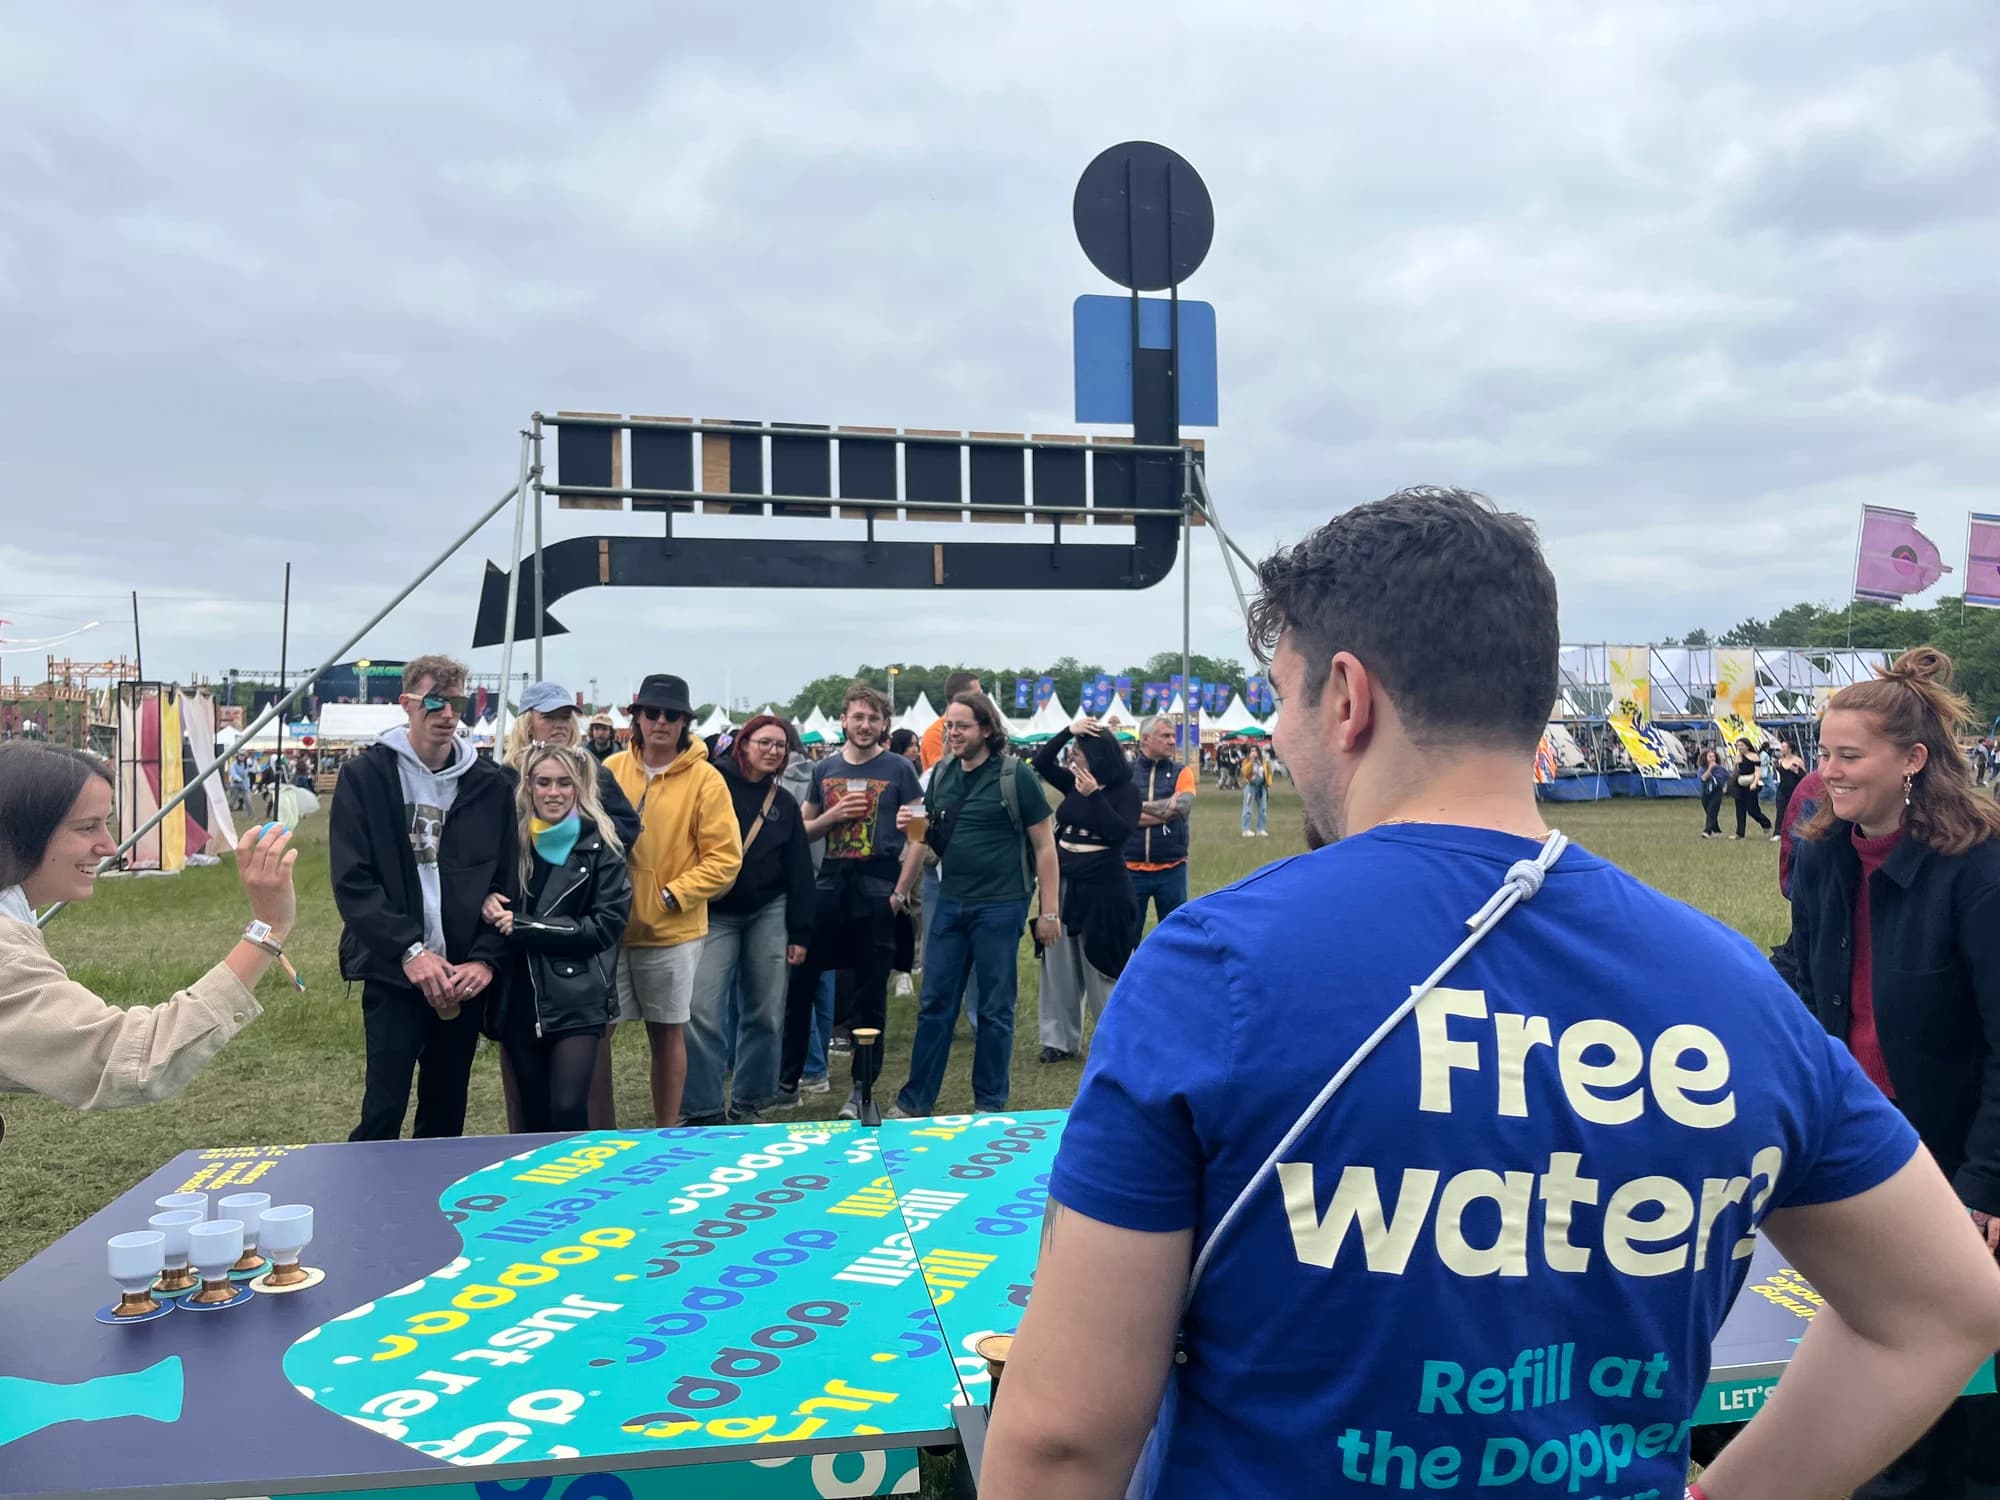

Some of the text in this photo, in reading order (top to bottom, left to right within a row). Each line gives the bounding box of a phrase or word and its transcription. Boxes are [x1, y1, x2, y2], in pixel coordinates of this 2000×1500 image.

[1410, 985, 1737, 1129] Free
[1418, 1342, 1669, 1414] Refill at
[1337, 1419, 1691, 1492] the Dopper
